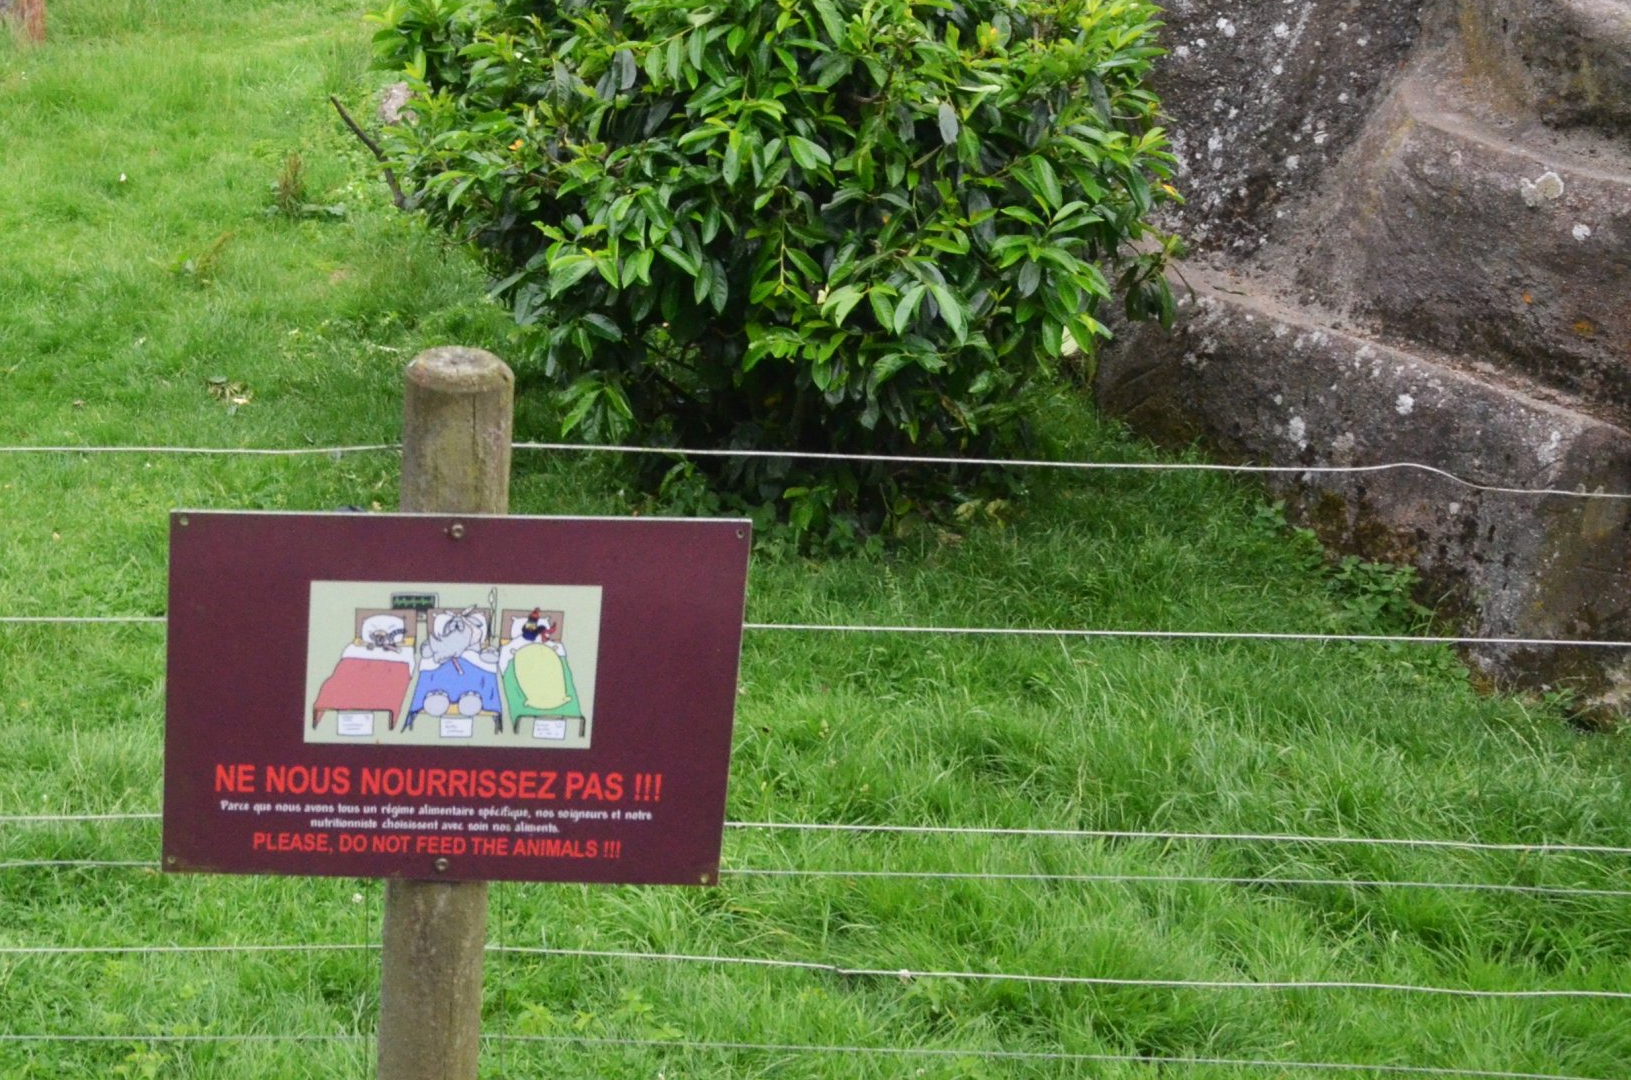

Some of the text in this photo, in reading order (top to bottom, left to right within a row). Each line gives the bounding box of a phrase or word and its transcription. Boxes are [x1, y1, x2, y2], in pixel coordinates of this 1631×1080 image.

[215, 764, 255, 793] NE
[266, 765, 351, 795] NOUS
[360, 768, 557, 800] NOURRISSEZ
[565, 772, 624, 801] PAS
[220, 800, 653, 822] Parce que nous avons tous un régime alimentaire spécifique, nos soigneurs et notre
[310, 818, 377, 829] nutritionniste
[381, 819, 439, 830] choisissent
[441, 821, 464, 831] avec
[468, 821, 488, 831] soin
[492, 823, 512, 832] nos
[253, 832, 333, 854] PLEASE,
[339, 833, 367, 853] DO
[372, 834, 410, 853] NOT
[416, 835, 467, 855] FEED
[472, 837, 508, 856] THE
[513, 838, 598, 858] ANIMALS
